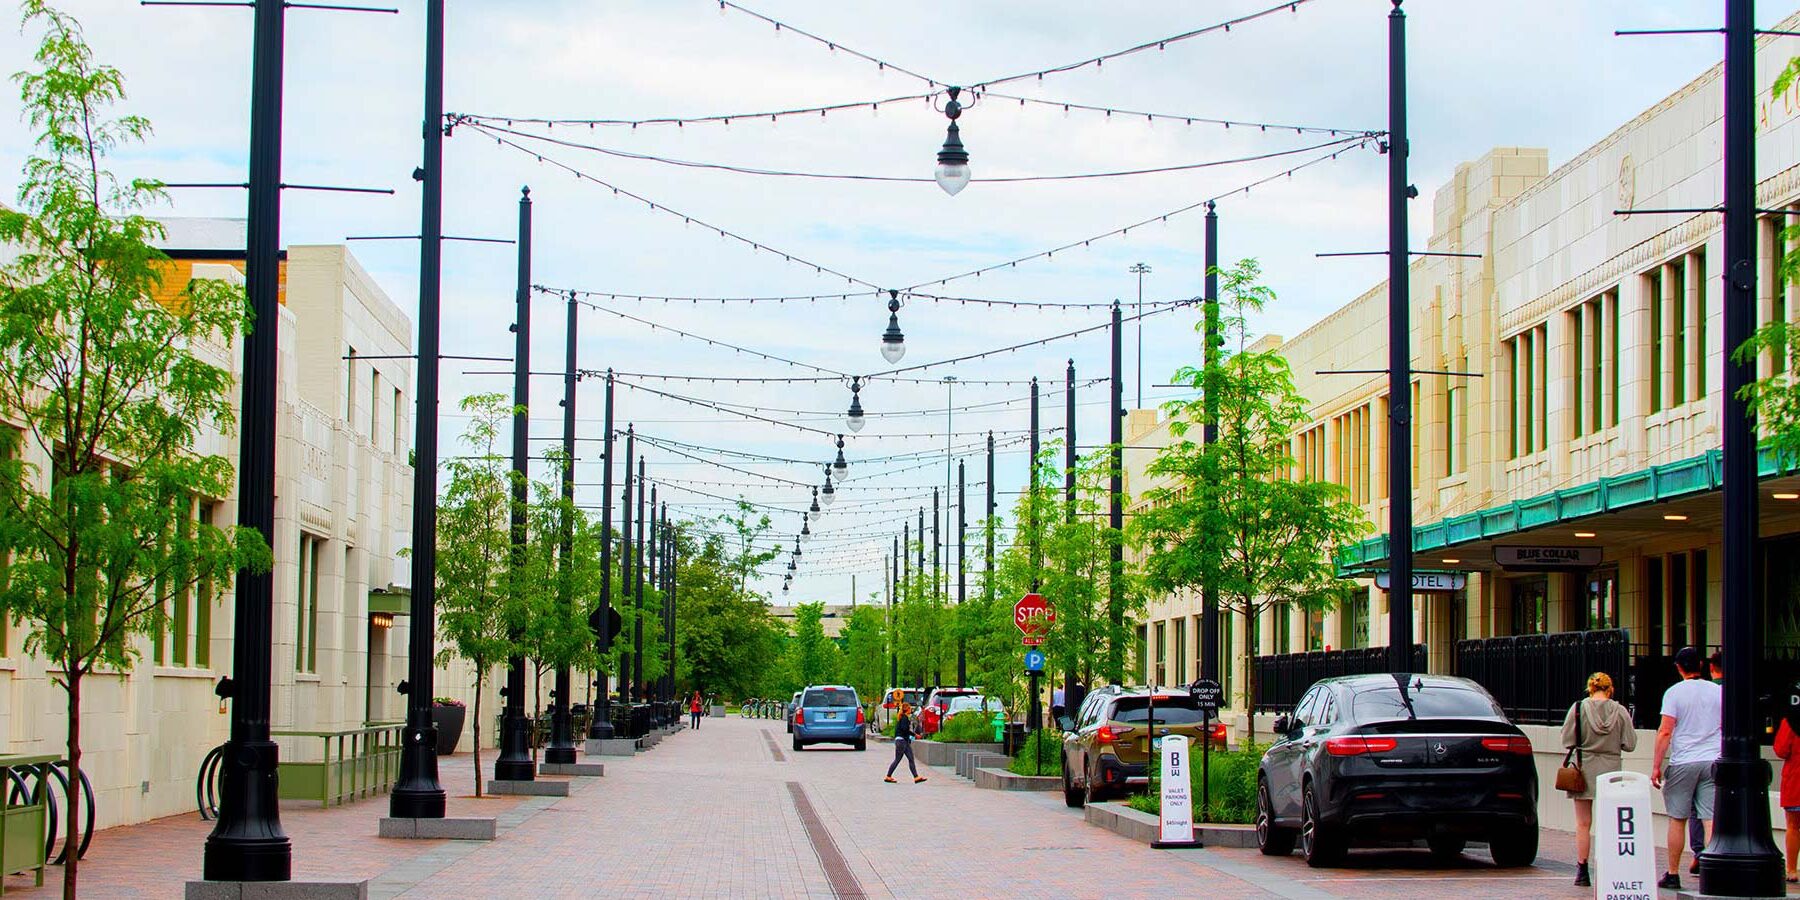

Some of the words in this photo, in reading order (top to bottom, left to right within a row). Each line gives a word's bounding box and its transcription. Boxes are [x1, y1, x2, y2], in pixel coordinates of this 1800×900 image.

[1517, 549, 1541, 560] BLUE
[1542, 549, 1580, 561] COLLAR
[1412, 575, 1444, 588] OTEL
[1030, 653, 1041, 668] P
[1171, 752, 1180, 767] B
[1171, 769, 1180, 777] W
[1617, 806, 1635, 835] B
[1618, 841, 1635, 856] W
[1612, 881, 1643, 890] VALET
